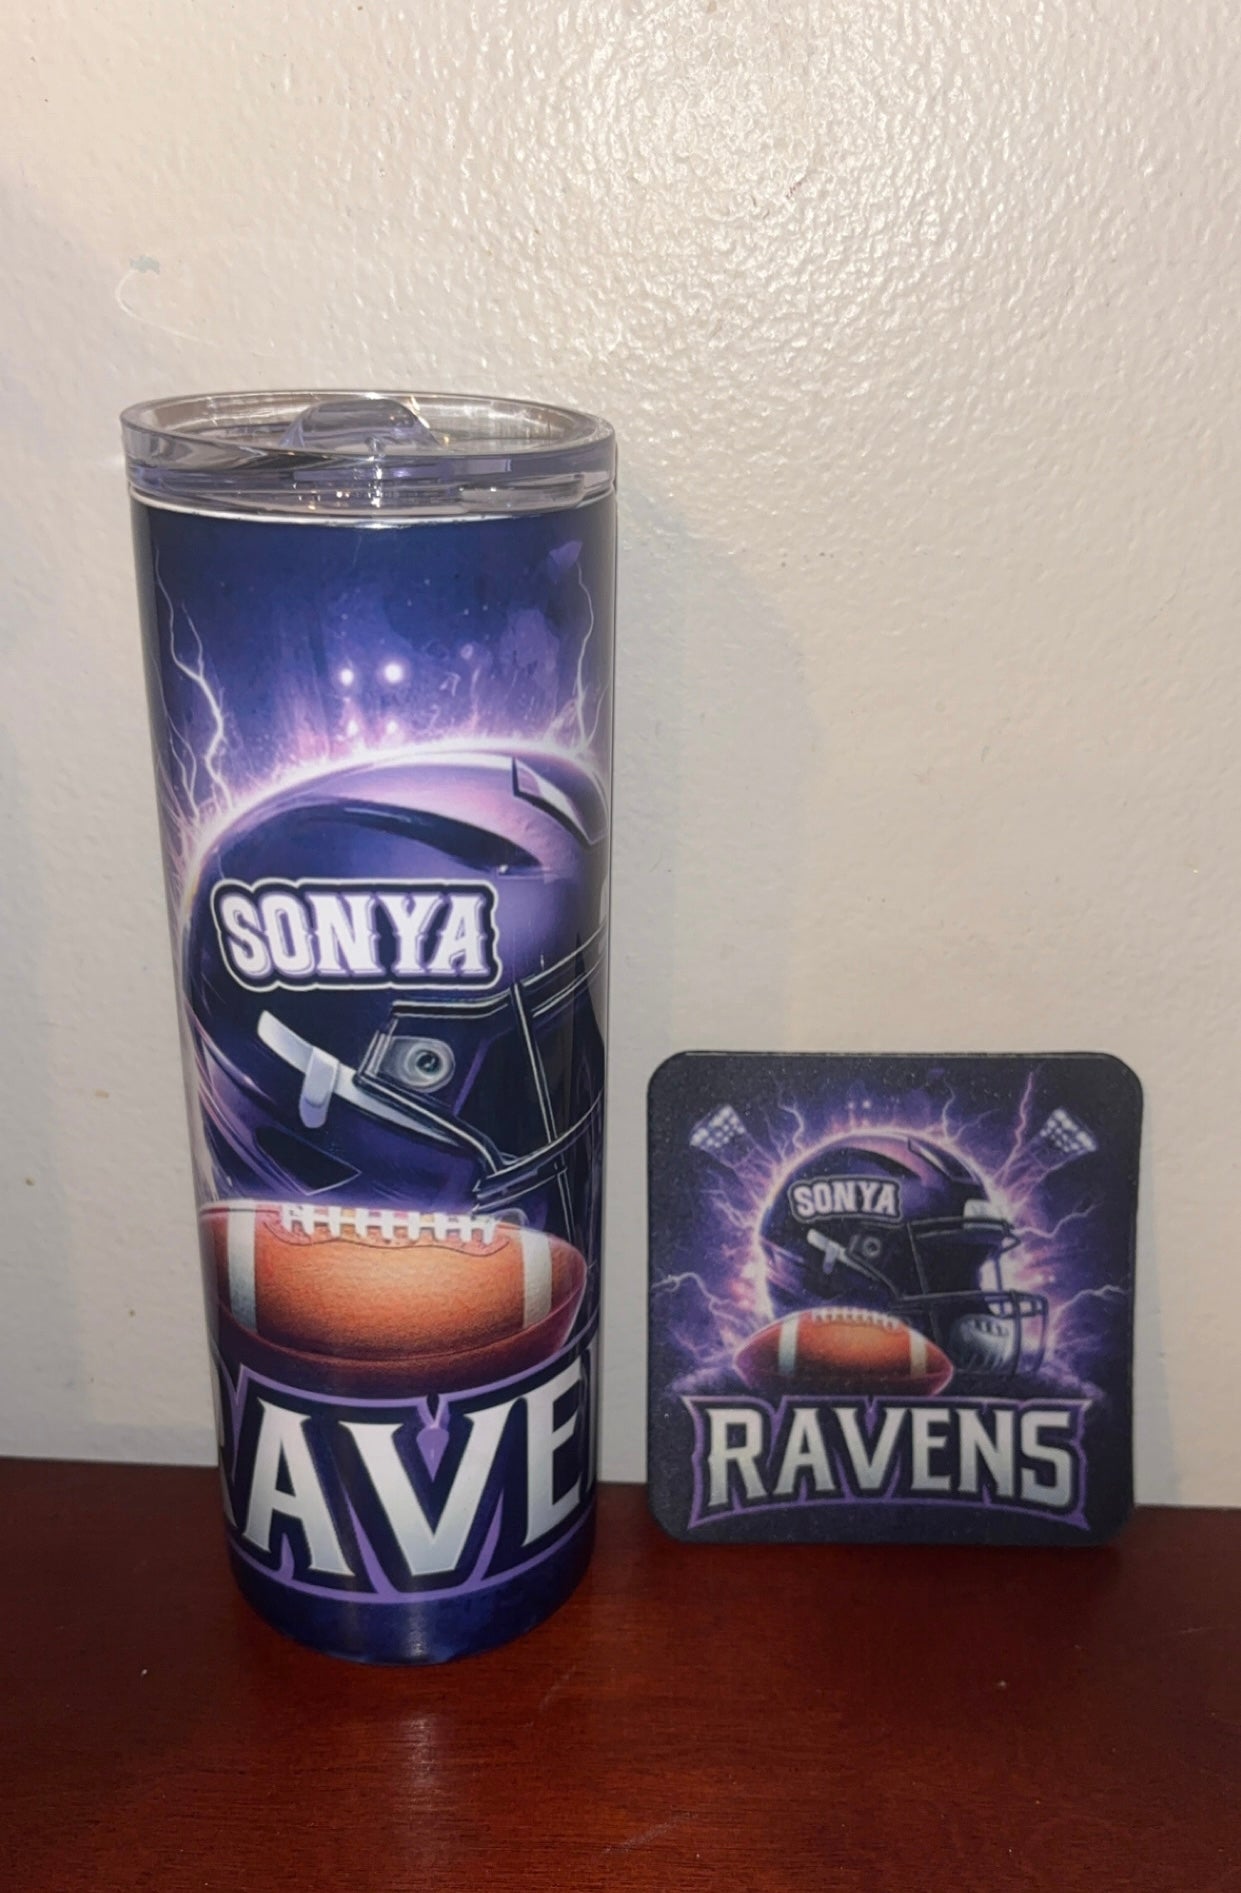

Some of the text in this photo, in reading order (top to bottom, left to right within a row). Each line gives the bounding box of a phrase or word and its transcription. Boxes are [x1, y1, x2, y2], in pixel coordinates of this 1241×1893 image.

[219, 891, 490, 978] SONYA
[793, 1181, 897, 1217] SONYA
[223, 1350, 592, 1577] AVE
[706, 1407, 1073, 1507] RAVENS
